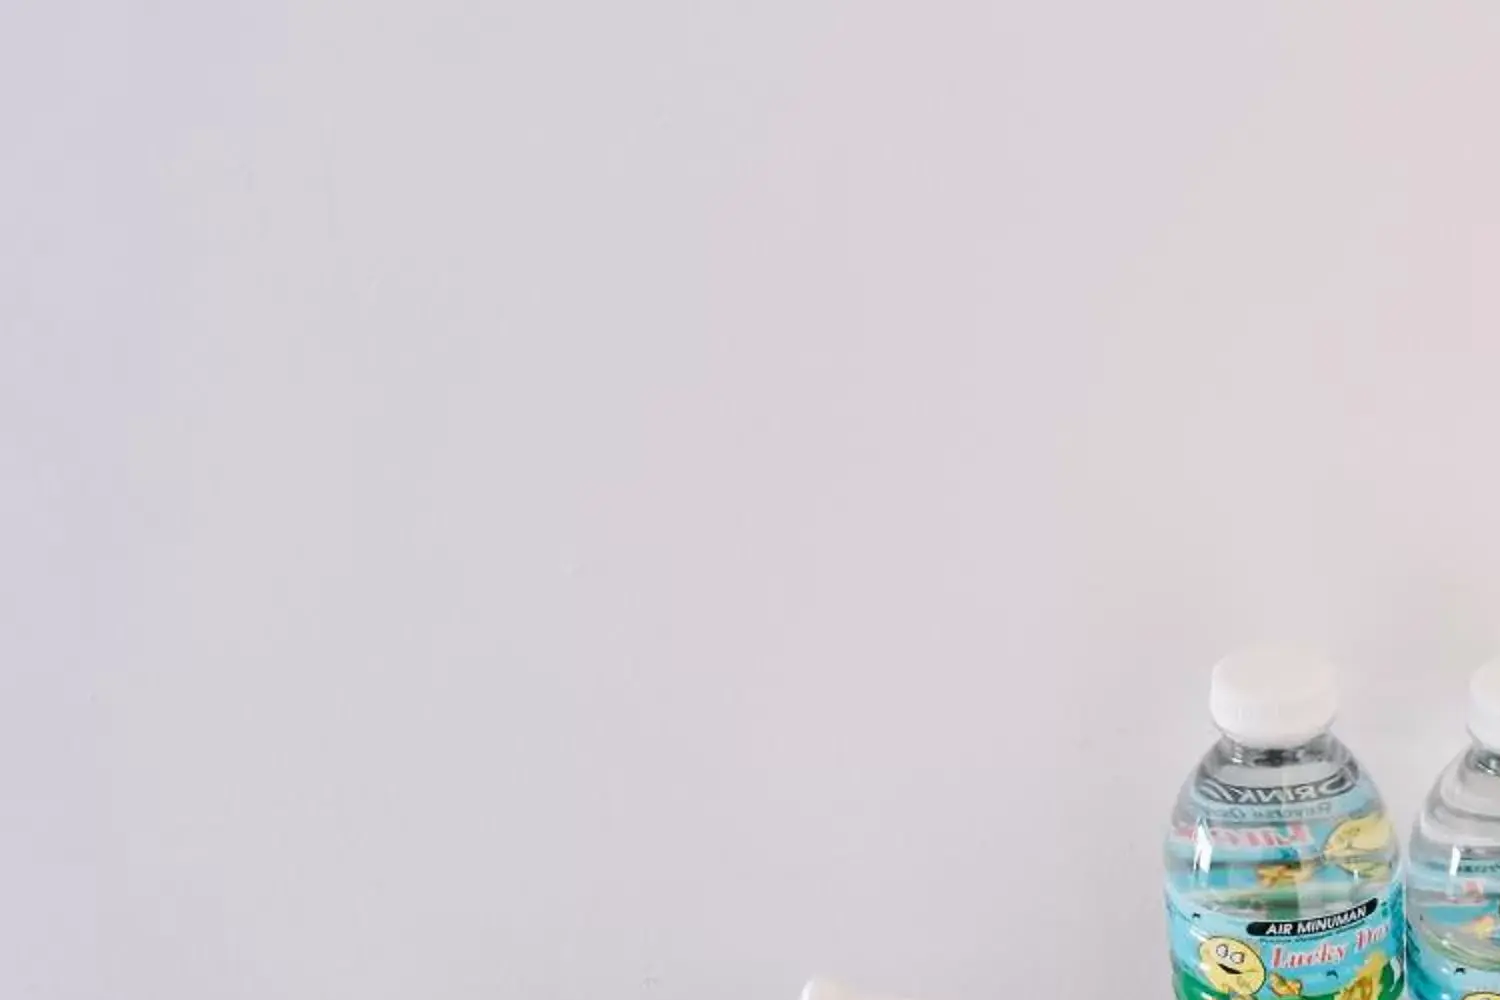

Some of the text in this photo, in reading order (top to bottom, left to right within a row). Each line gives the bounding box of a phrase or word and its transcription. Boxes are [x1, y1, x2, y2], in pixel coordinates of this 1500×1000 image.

[1265, 923, 1293, 936] AIR
[1297, 905, 1367, 935] MINUMAN
[1271, 940, 1347, 969] Lucky
